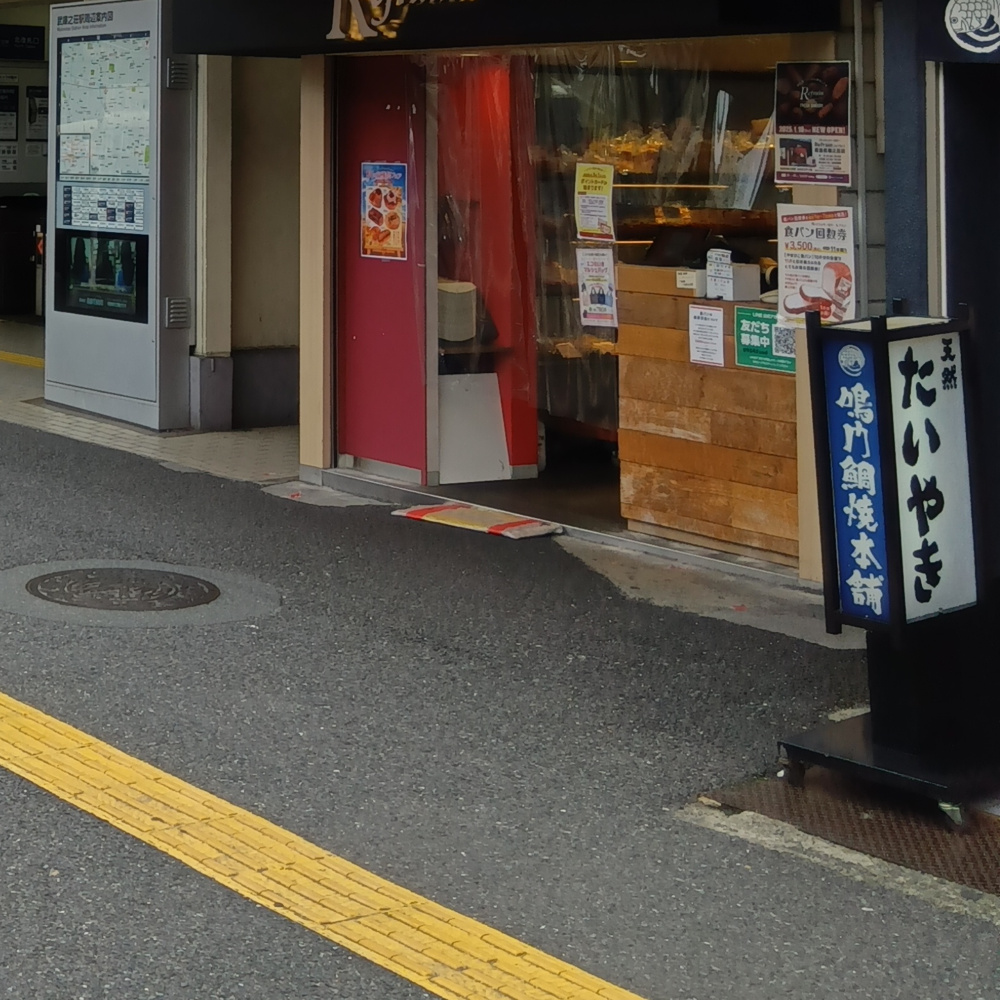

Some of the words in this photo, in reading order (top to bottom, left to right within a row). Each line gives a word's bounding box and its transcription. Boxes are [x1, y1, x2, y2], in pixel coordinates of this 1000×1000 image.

[784, 225, 848, 241] 食パン回数券
[740, 319, 770, 334] 友だち
[740, 333, 770, 348] 募集中
[940, 337, 958, 390] 天然
[898, 346, 945, 603] たいやき
